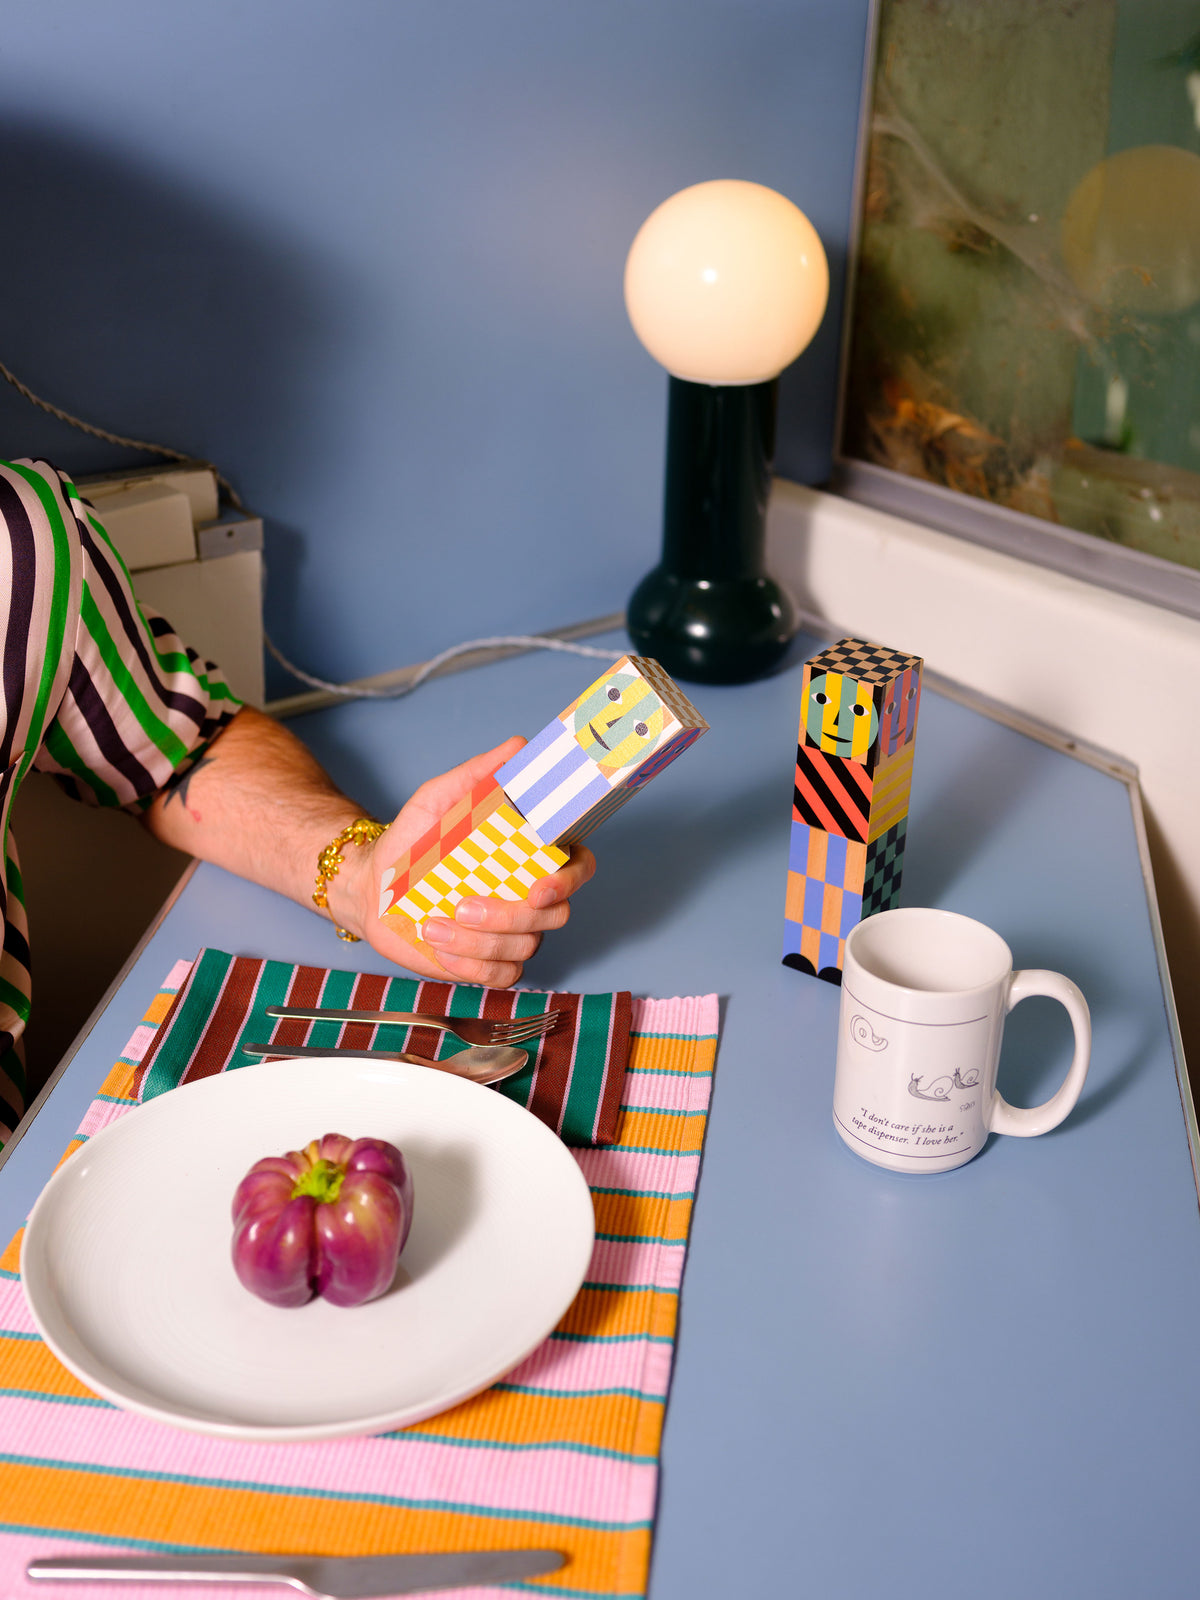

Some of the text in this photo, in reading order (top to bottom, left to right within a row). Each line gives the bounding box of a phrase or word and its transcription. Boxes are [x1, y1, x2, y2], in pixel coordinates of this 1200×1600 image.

[852, 1116, 867, 1130] tape
[868, 1126, 909, 1144] dispenser.
[915, 1137, 921, 1145] I
[922, 1137, 942, 1146] love
[868, 1113, 889, 1127] don't
[891, 1122, 909, 1131] care
[912, 1124, 923, 1135] if
[922, 1124, 936, 1133] she
[938, 1124, 946, 1133] is
